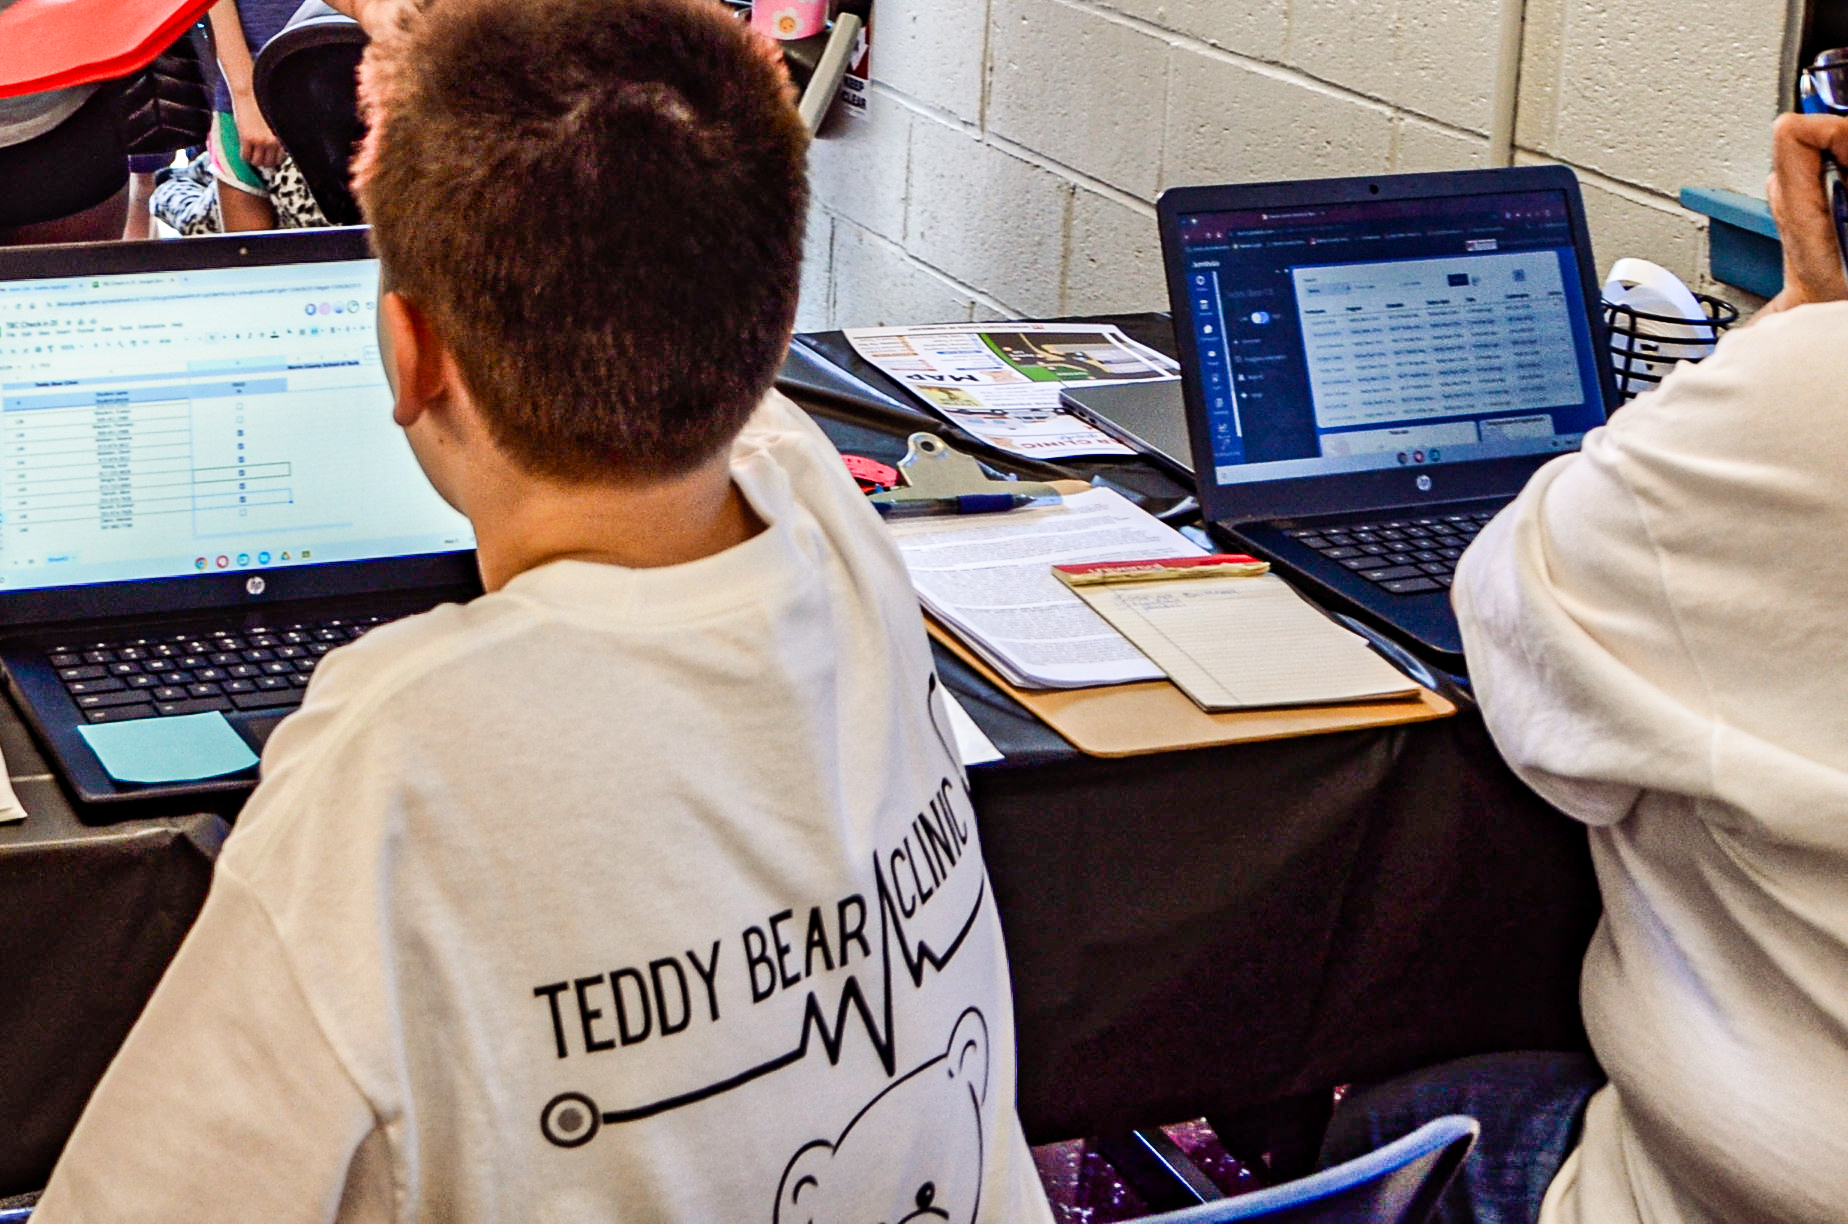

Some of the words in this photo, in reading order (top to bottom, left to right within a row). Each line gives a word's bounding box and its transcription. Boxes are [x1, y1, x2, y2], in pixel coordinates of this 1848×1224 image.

[905, 373, 980, 382] MAP
[1020, 438, 1094, 450] CLINIC
[532, 940, 721, 1060] TEDDY
[742, 893, 873, 1005] BEAR
[888, 776, 970, 920] CLINIC
